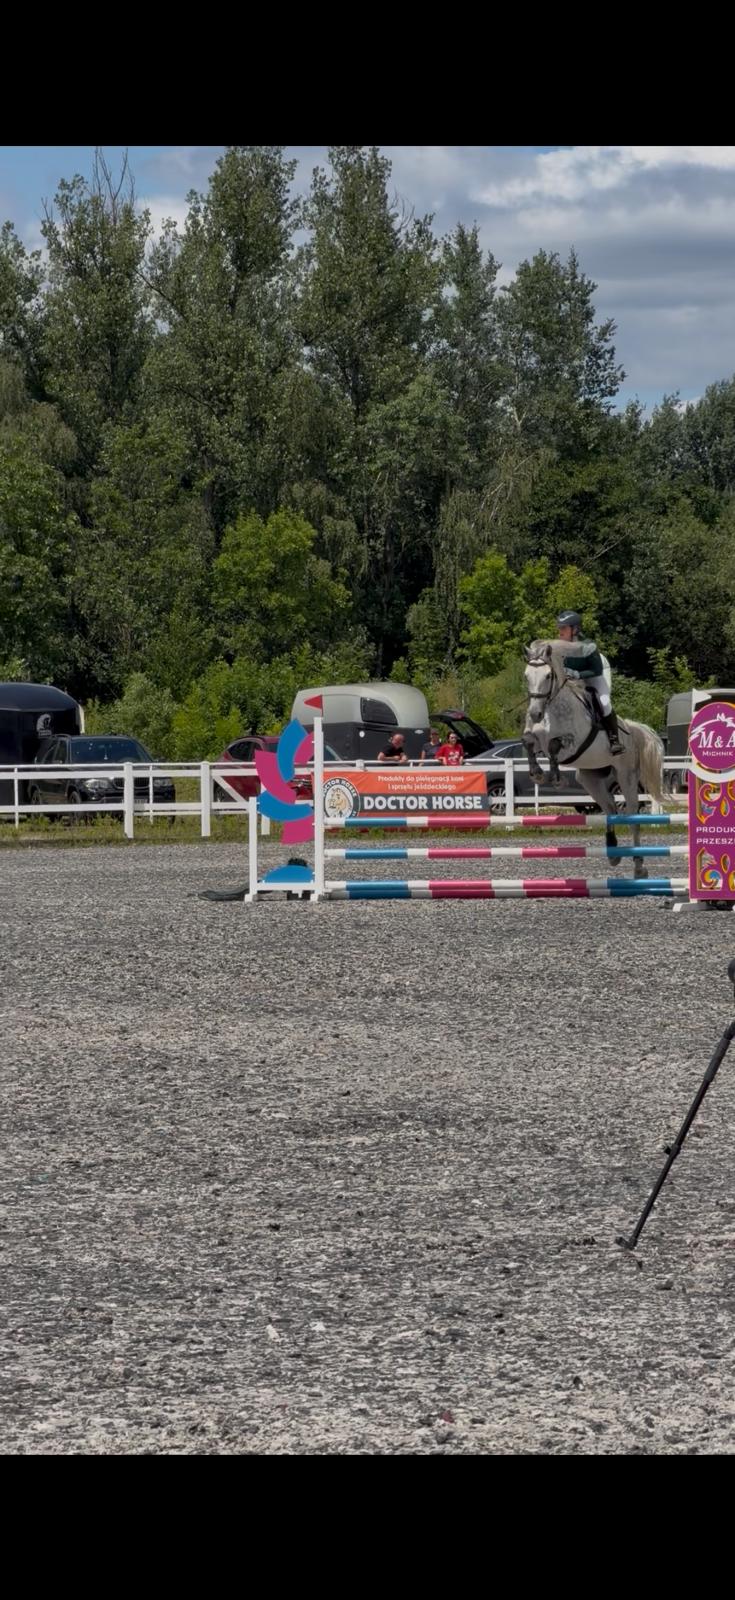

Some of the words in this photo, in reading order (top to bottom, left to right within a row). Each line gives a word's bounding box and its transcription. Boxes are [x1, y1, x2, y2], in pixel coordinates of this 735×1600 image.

[377, 776, 405, 784] Produkty
[363, 796, 428, 810] DOCTOR
[432, 796, 483, 810] HORSE
